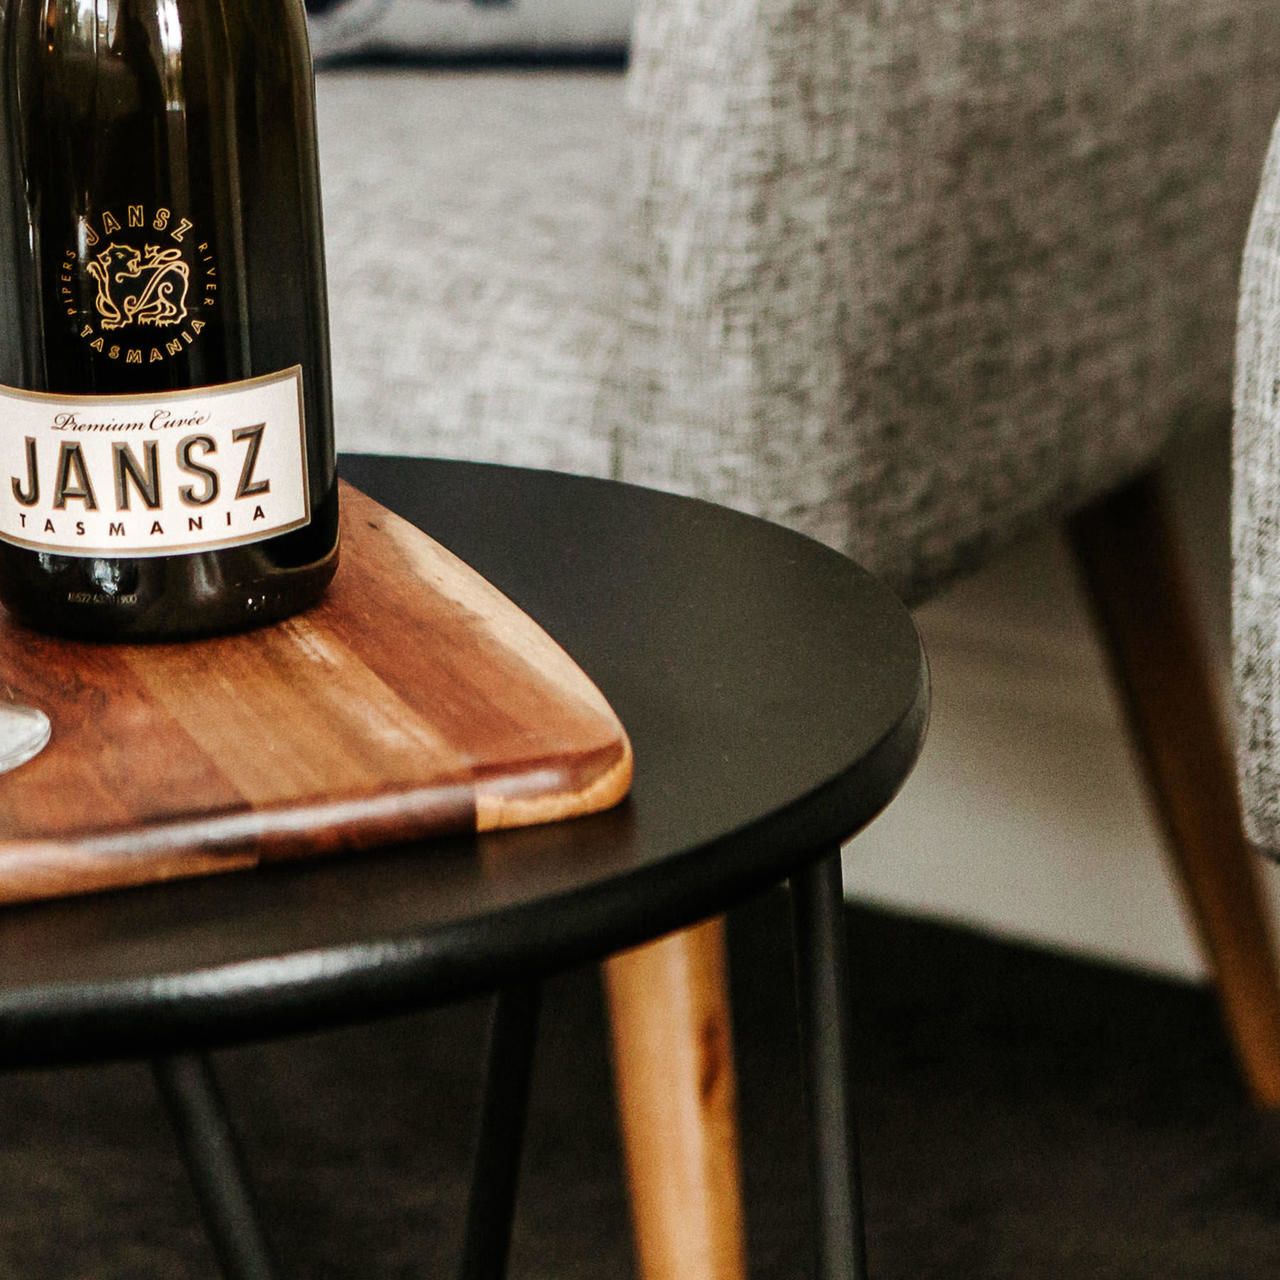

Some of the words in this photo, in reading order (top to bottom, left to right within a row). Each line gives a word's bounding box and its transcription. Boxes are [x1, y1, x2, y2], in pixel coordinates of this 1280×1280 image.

[84, 205, 193, 246] JANSZ
[61, 249, 77, 316] PIPERS
[198, 242, 217, 306] RIVER
[80, 319, 206, 363] TASMANIA
[51, 411, 145, 432] Premium
[149, 408, 211, 431] Cuvée
[11, 422, 271, 513] JANSZ
[19, 505, 265, 538] TASMANIA
